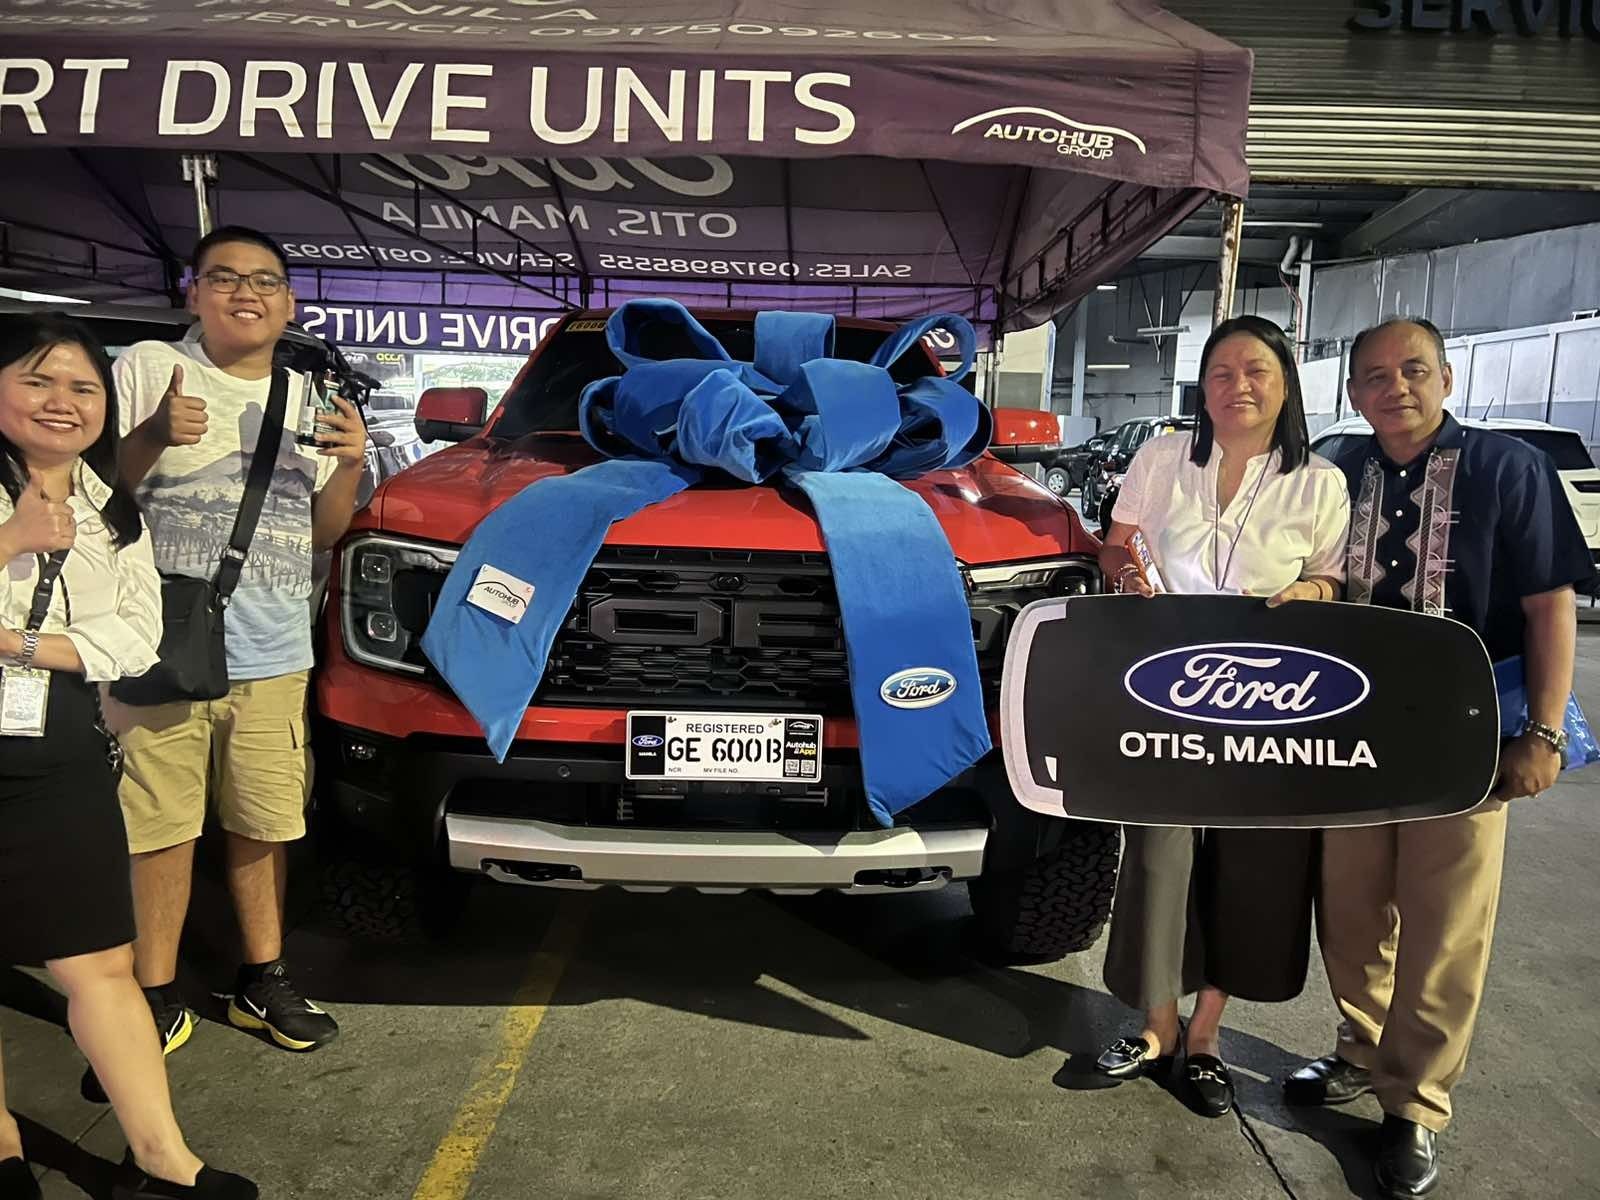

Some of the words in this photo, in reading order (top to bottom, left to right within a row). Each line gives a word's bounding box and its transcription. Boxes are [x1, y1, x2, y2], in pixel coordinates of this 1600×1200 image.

[203, 11, 508, 35] SERVICE:
[157, 60, 494, 144] DRIVE
[529, 66, 856, 145] UNITS
[984, 123, 1114, 149] AUTOHUB
[1056, 143, 1114, 160] GROUP
[484, 586, 520, 605] AUTOHUB
[896, 676, 942, 699] Ford
[1168, 652, 1322, 713] Ford
[685, 723, 765, 734] REGISTERED
[667, 736, 702, 762] GE
[1119, 732, 1215, 766] OTIS,
[1223, 735, 1378, 769] MANILA
